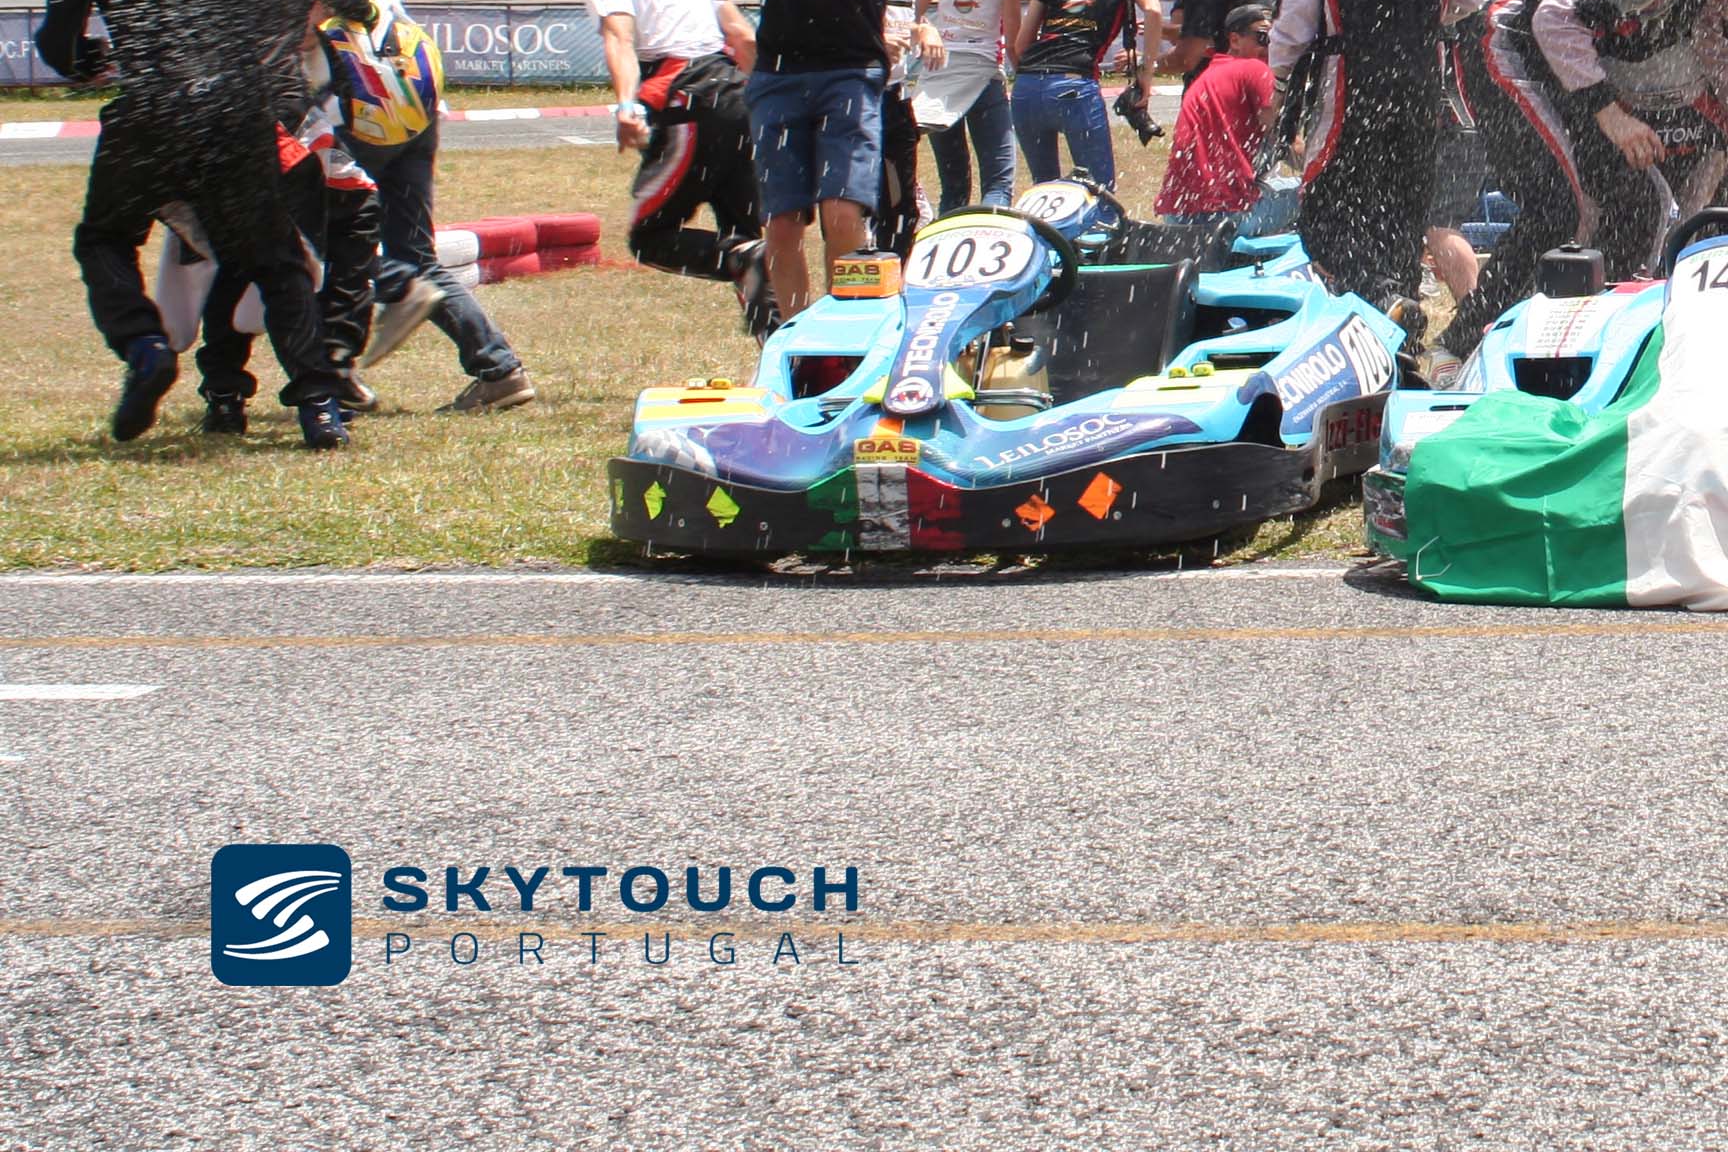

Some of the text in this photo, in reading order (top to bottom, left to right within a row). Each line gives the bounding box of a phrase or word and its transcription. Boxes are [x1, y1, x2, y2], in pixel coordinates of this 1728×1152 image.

[416, 23, 569, 54] ILOSOC
[455, 60, 504, 71] MARKET
[920, 237, 1012, 280] 103
[901, 292, 960, 377] TECNIROLO
[858, 440, 917, 453] GAS
[974, 412, 1127, 469] LEILOSOC
